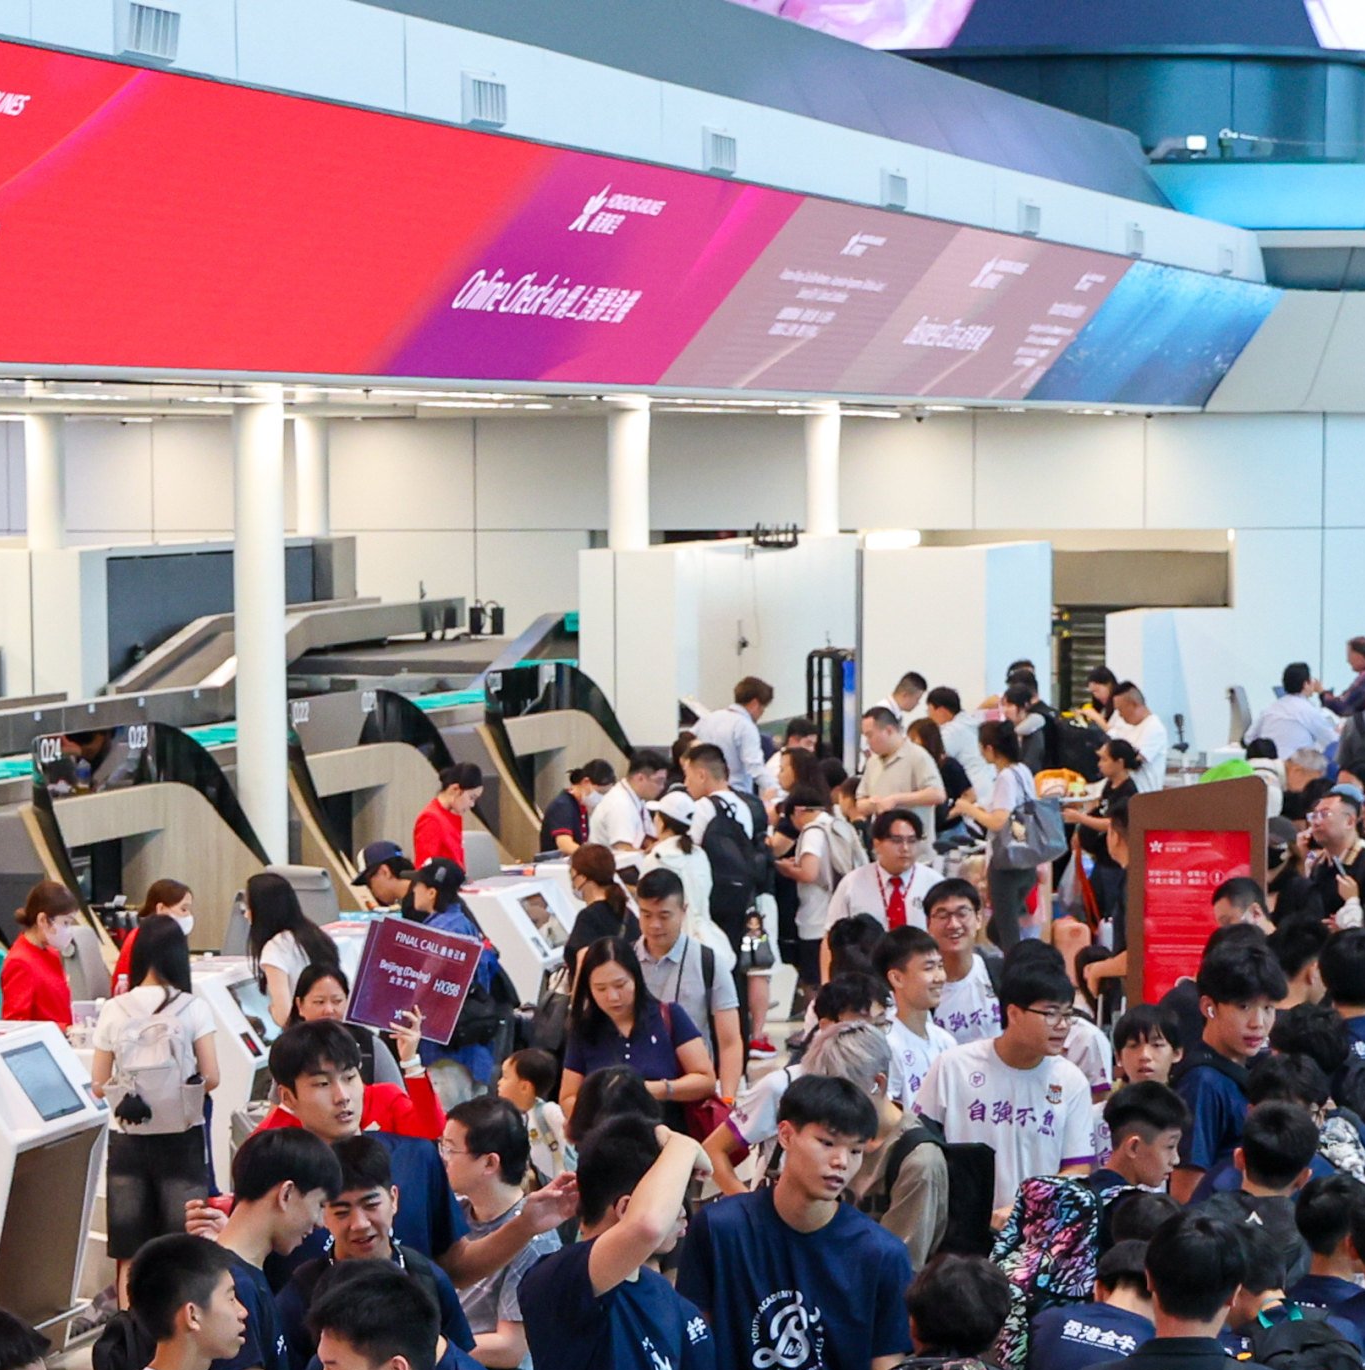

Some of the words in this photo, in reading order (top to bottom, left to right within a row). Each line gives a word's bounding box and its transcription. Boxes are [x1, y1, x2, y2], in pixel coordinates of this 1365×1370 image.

[40, 738, 63, 764] Q24
[128, 723, 149, 750] Q23
[395, 931, 419, 948] FINAL
[420, 939, 440, 954] CALL
[968, 1098, 1056, 1137] 自強不息
[751, 1312, 761, 1346] YOUTH
[758, 1290, 794, 1314] ACADEMY
[1063, 1319, 1137, 1352] 香港金牛
